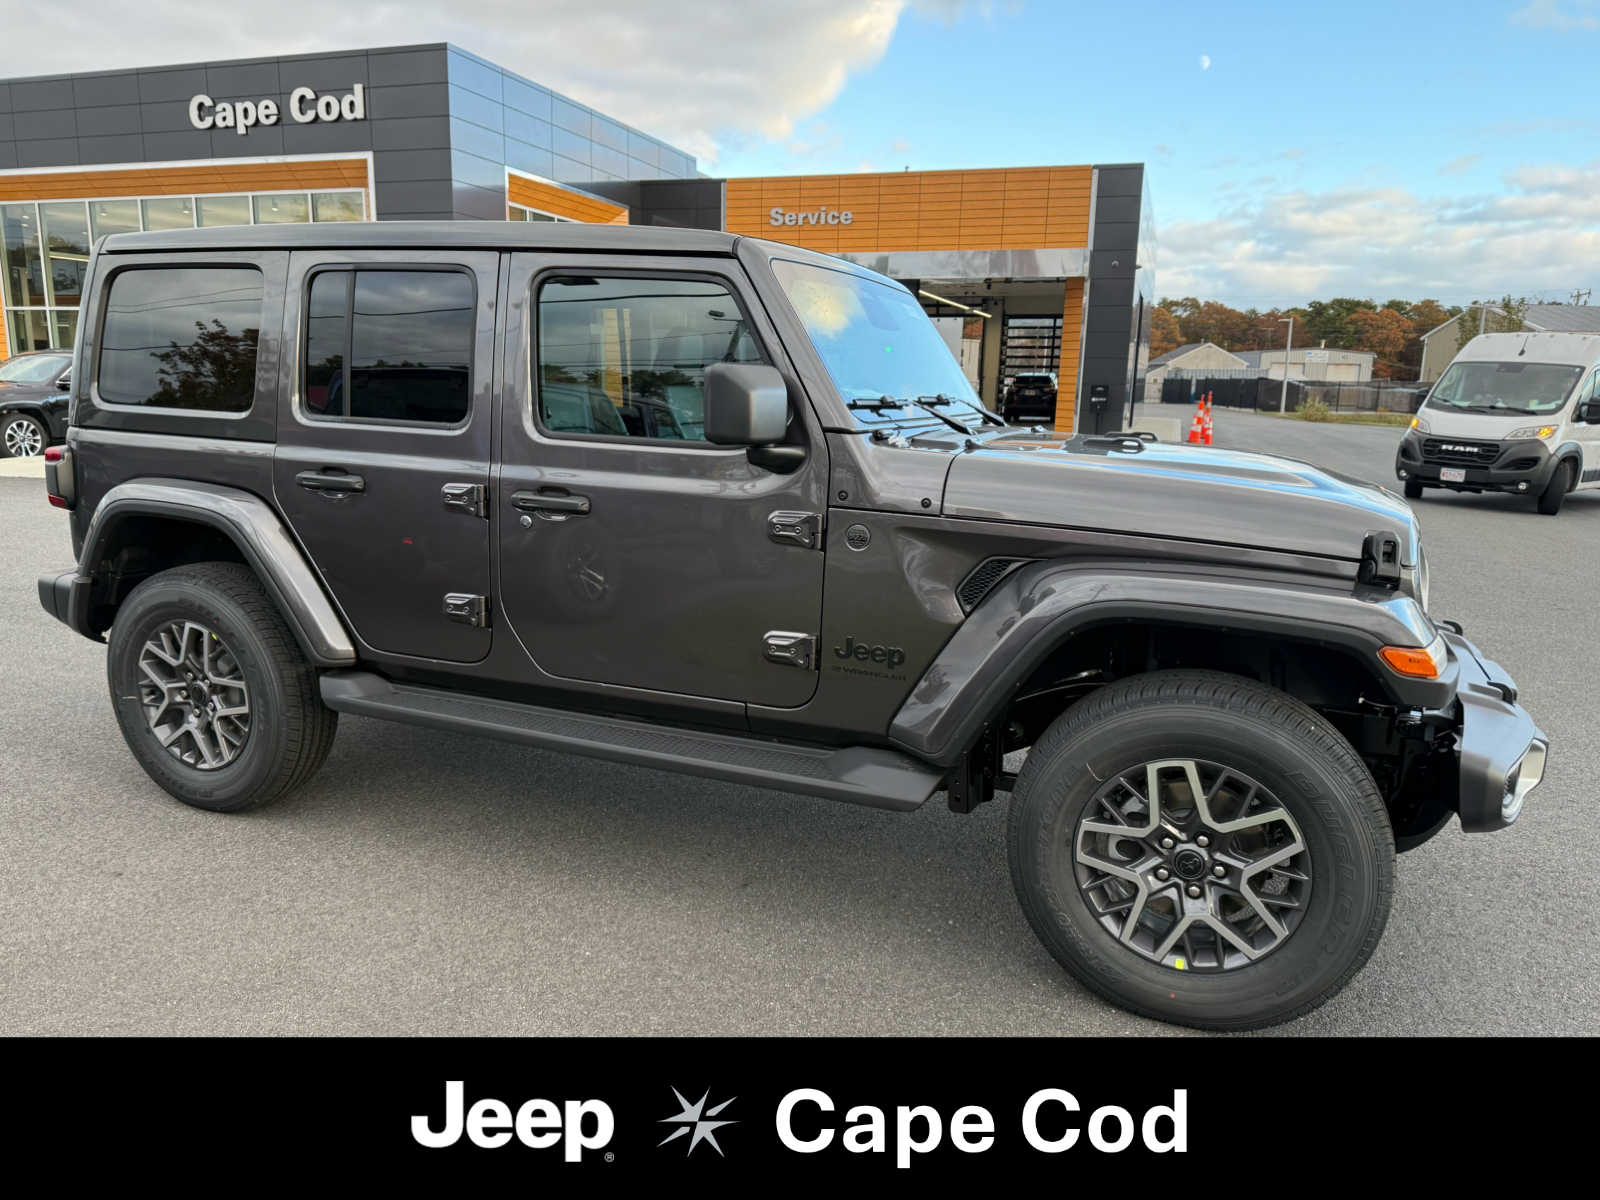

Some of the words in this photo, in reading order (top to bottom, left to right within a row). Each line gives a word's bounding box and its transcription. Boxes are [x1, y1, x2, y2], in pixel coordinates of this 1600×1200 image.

[189, 94, 280, 135] Cape
[290, 83, 366, 123] Cod
[769, 206, 854, 226] Service
[1441, 444, 1479, 453] RAM
[833, 635, 906, 670] Jeep
